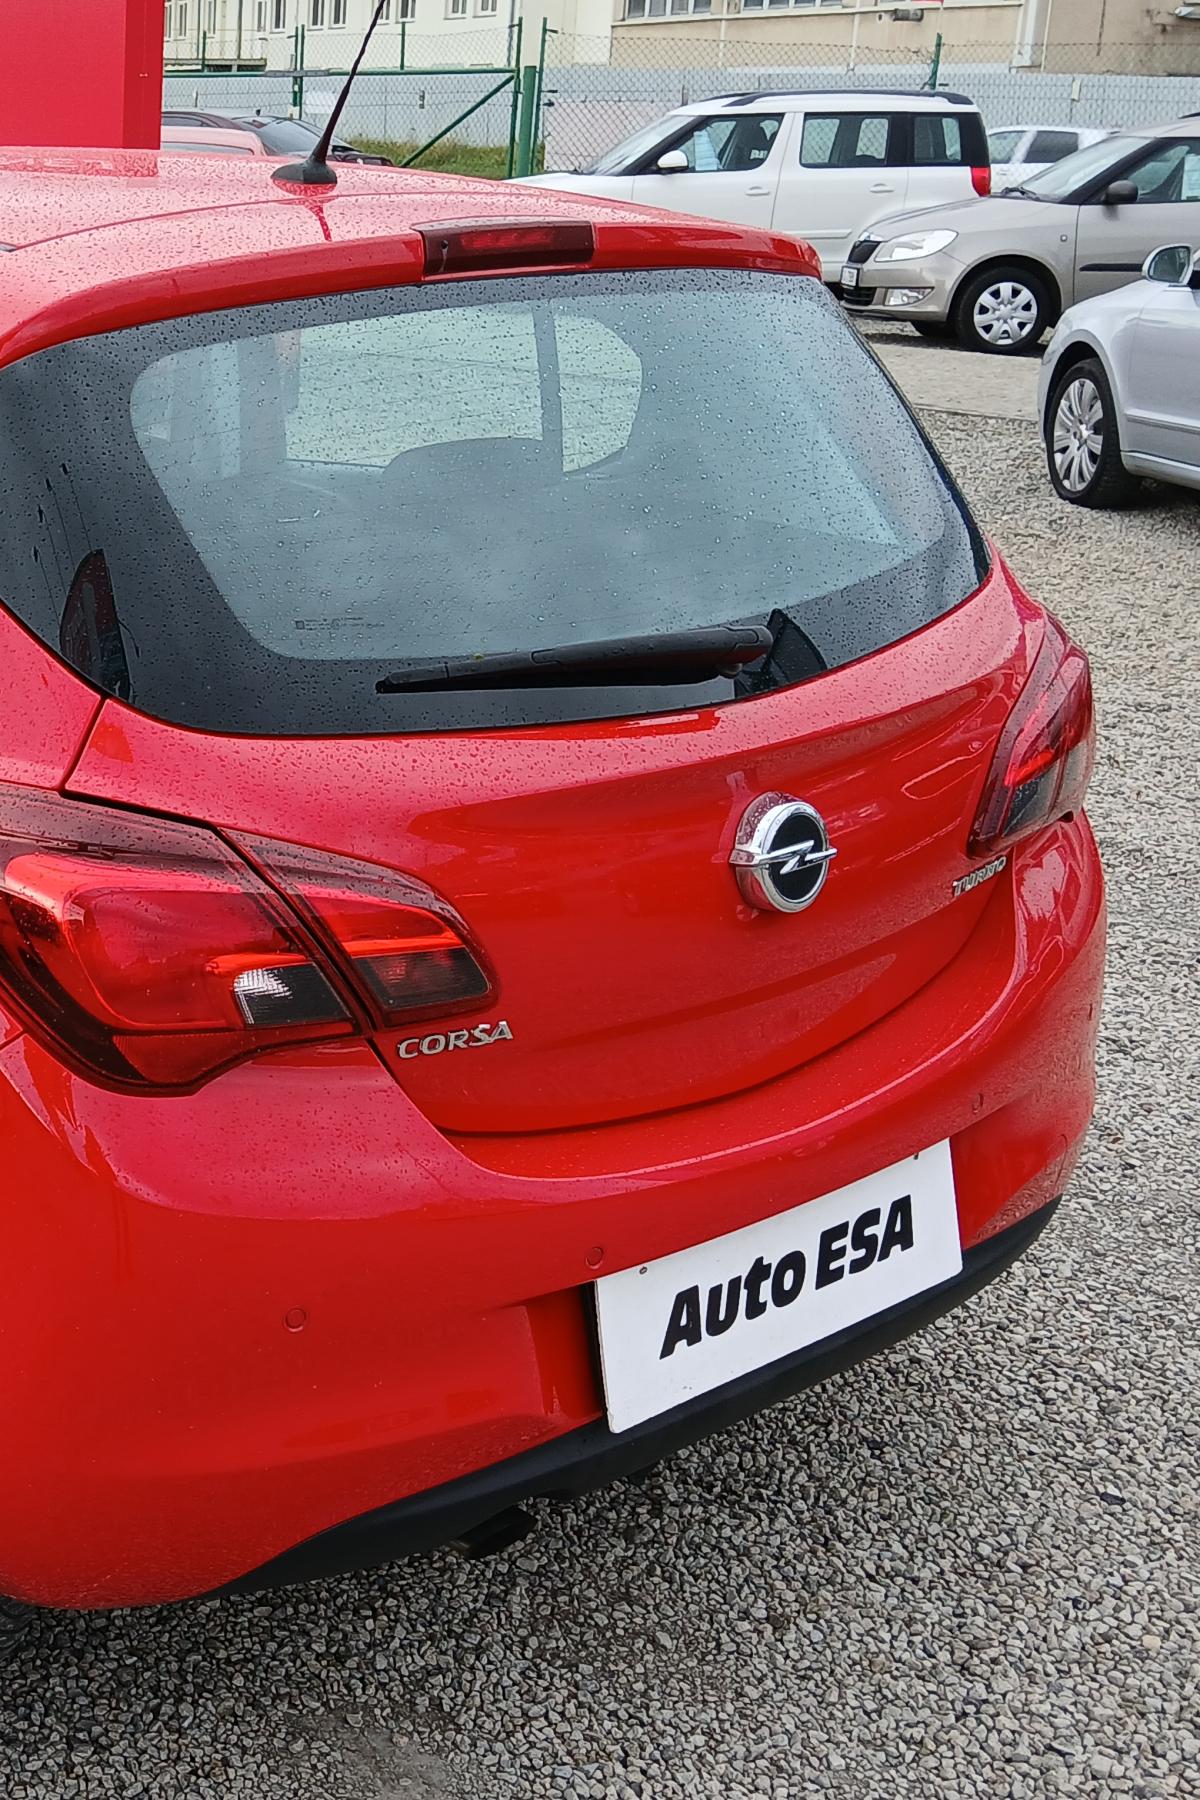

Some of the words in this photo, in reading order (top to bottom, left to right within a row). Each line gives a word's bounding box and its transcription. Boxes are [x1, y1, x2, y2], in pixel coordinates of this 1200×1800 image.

[397, 1020, 514, 1059] CORSA
[659, 1250, 806, 1360] Auto
[815, 1194, 914, 1291] ESA
